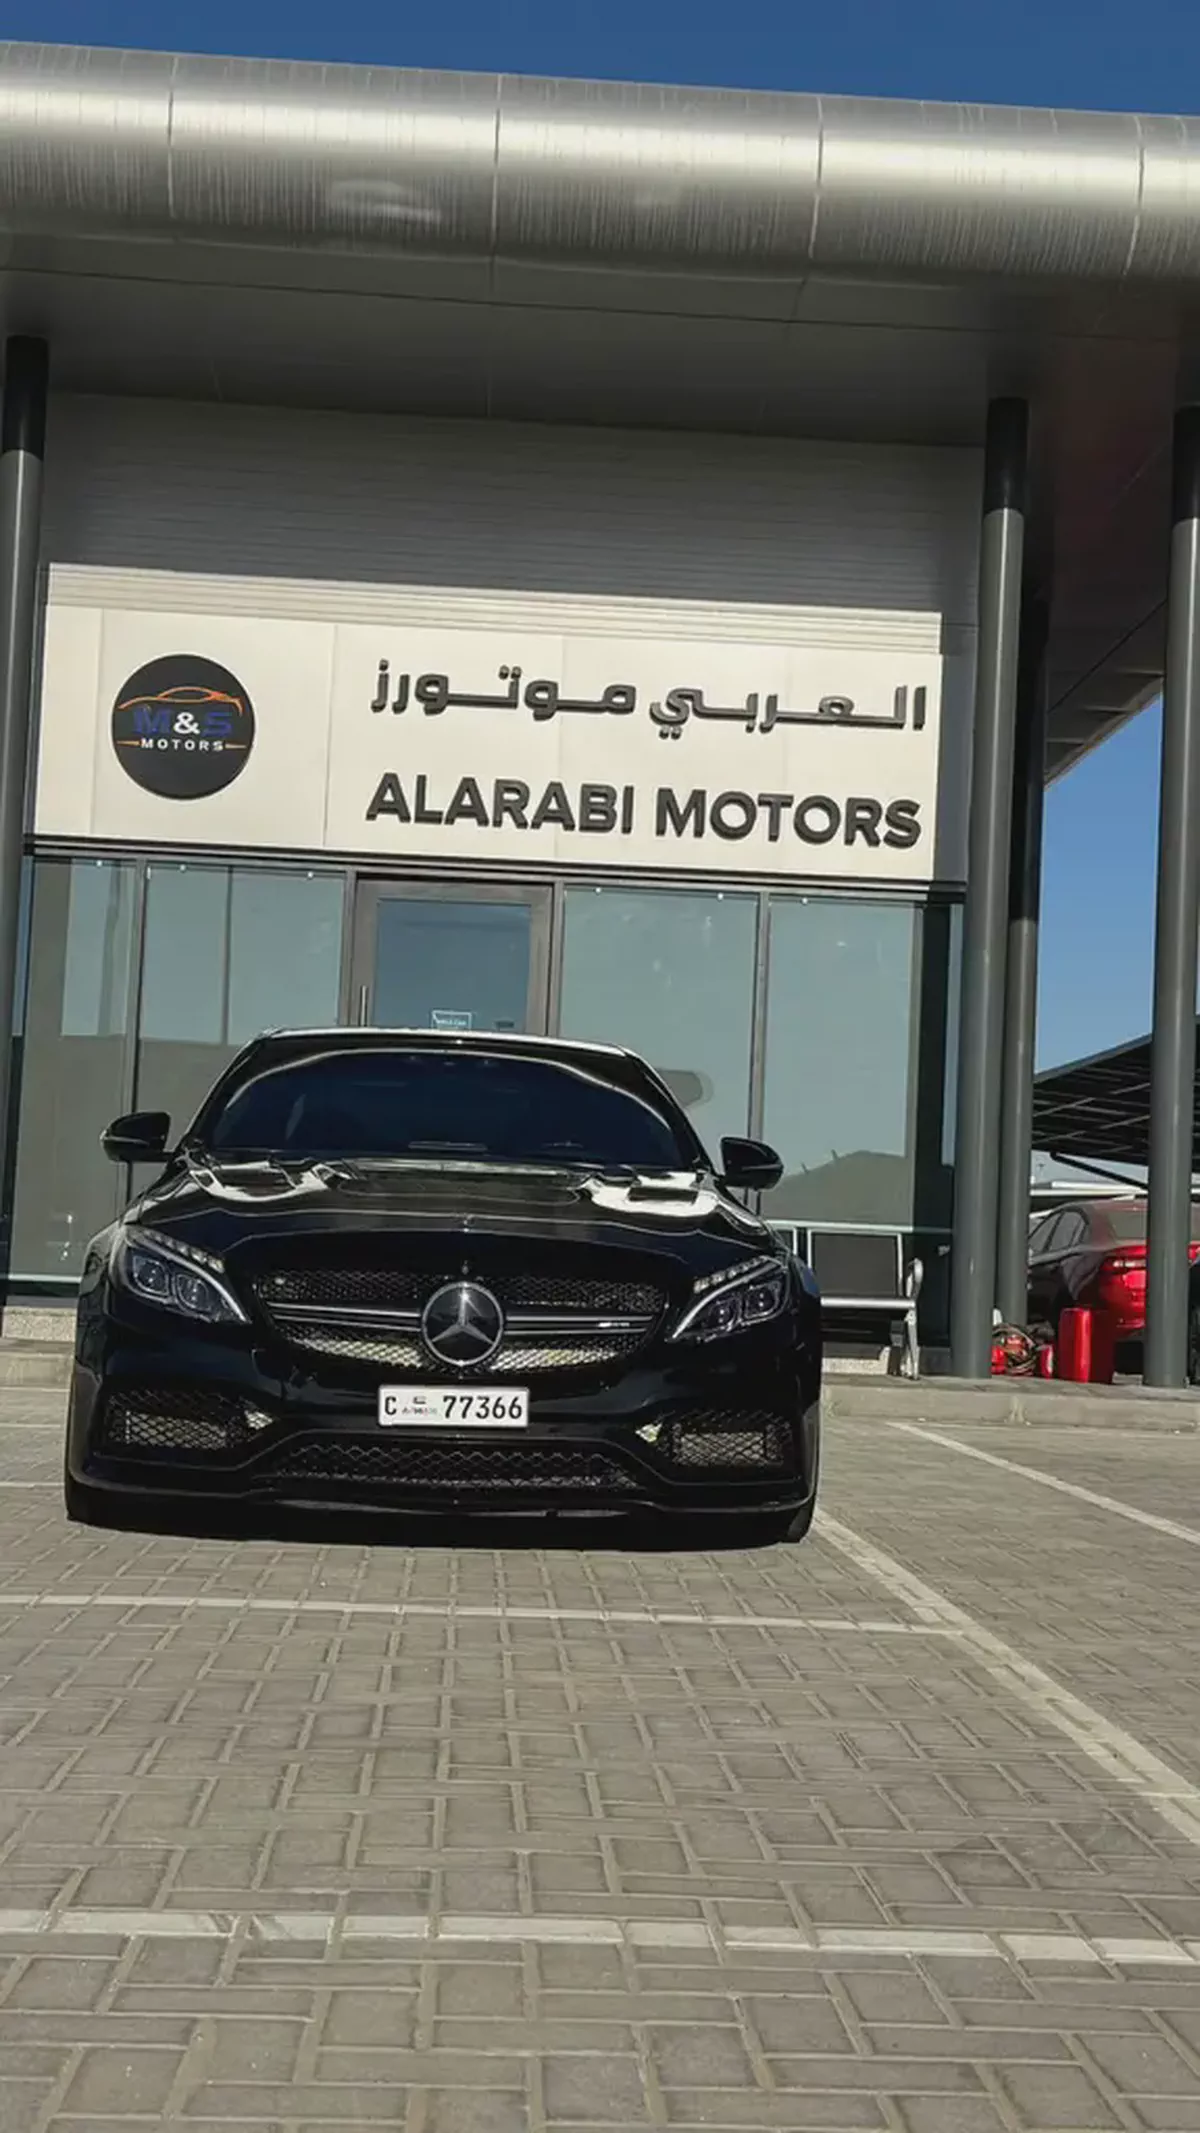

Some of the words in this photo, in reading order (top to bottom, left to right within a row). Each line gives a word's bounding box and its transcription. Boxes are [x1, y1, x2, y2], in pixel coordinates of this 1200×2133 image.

[370, 659, 637, 721] موتورز
[649, 684, 927, 739] العربي
[132, 704, 232, 737] M&S
[141, 738, 223, 751] MOTORS
[365, 772, 634, 834] ALARABI
[655, 787, 921, 849] MOTORS
[384, 1396, 397, 1416] C
[443, 1395, 523, 1420] 77366
